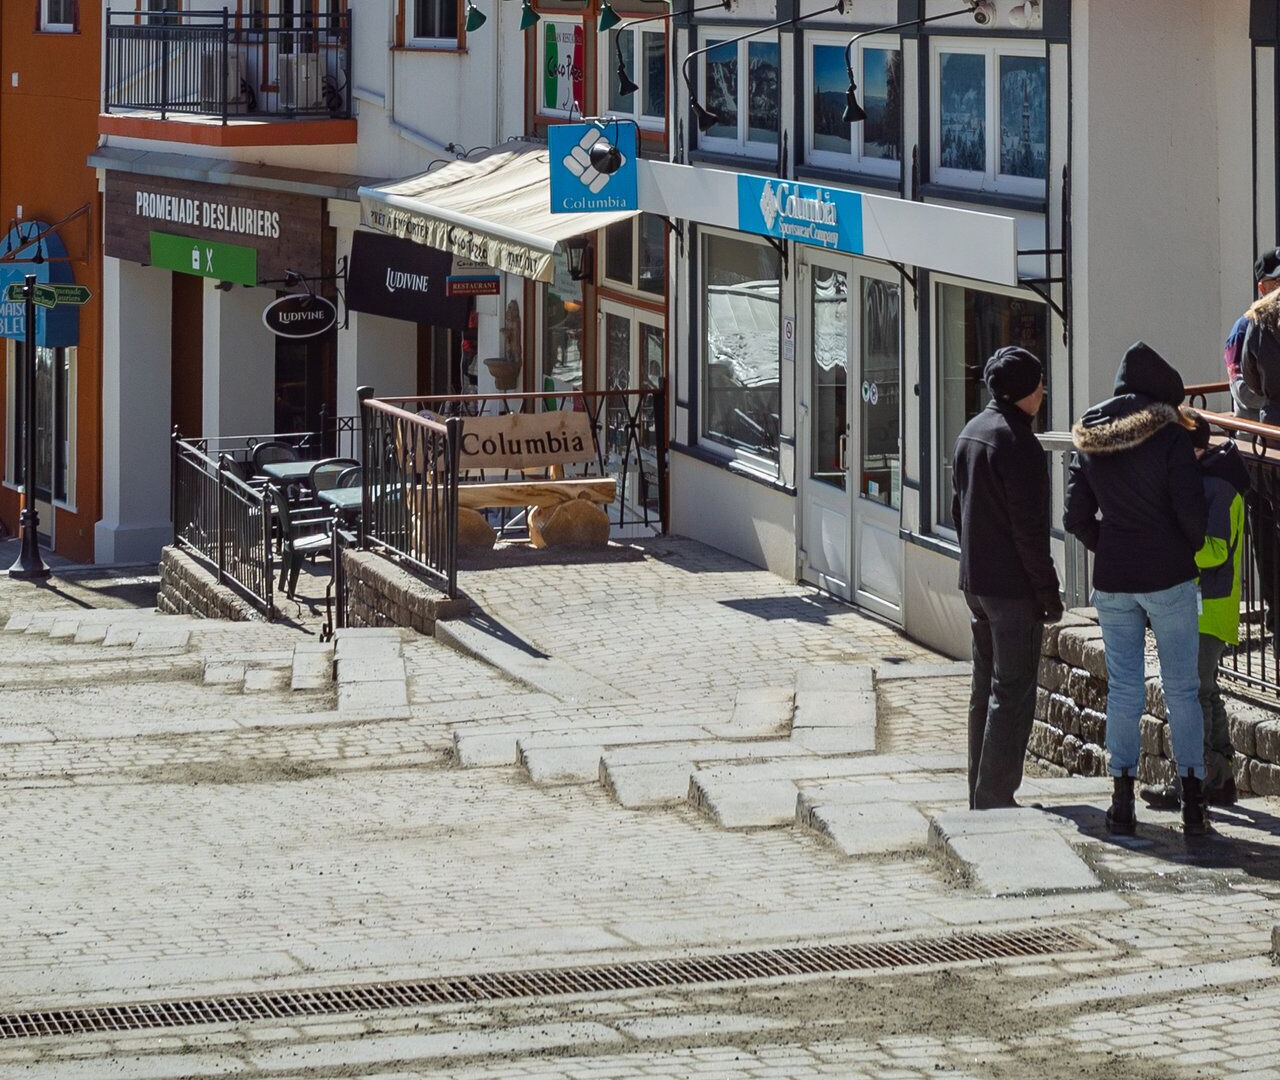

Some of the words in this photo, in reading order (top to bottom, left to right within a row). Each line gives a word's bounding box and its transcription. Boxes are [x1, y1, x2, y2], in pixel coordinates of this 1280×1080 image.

[136, 191, 200, 226] PROMENADE
[202, 201, 280, 239] DESLAURIERS
[563, 197, 626, 209] Columbia
[776, 183, 836, 226] Columbia
[386, 267, 430, 293] LUDIVINE
[452, 282, 497, 290] RESTAURANT
[279, 311, 325, 323] LUDIVINE
[461, 431, 584, 455] Columbia
